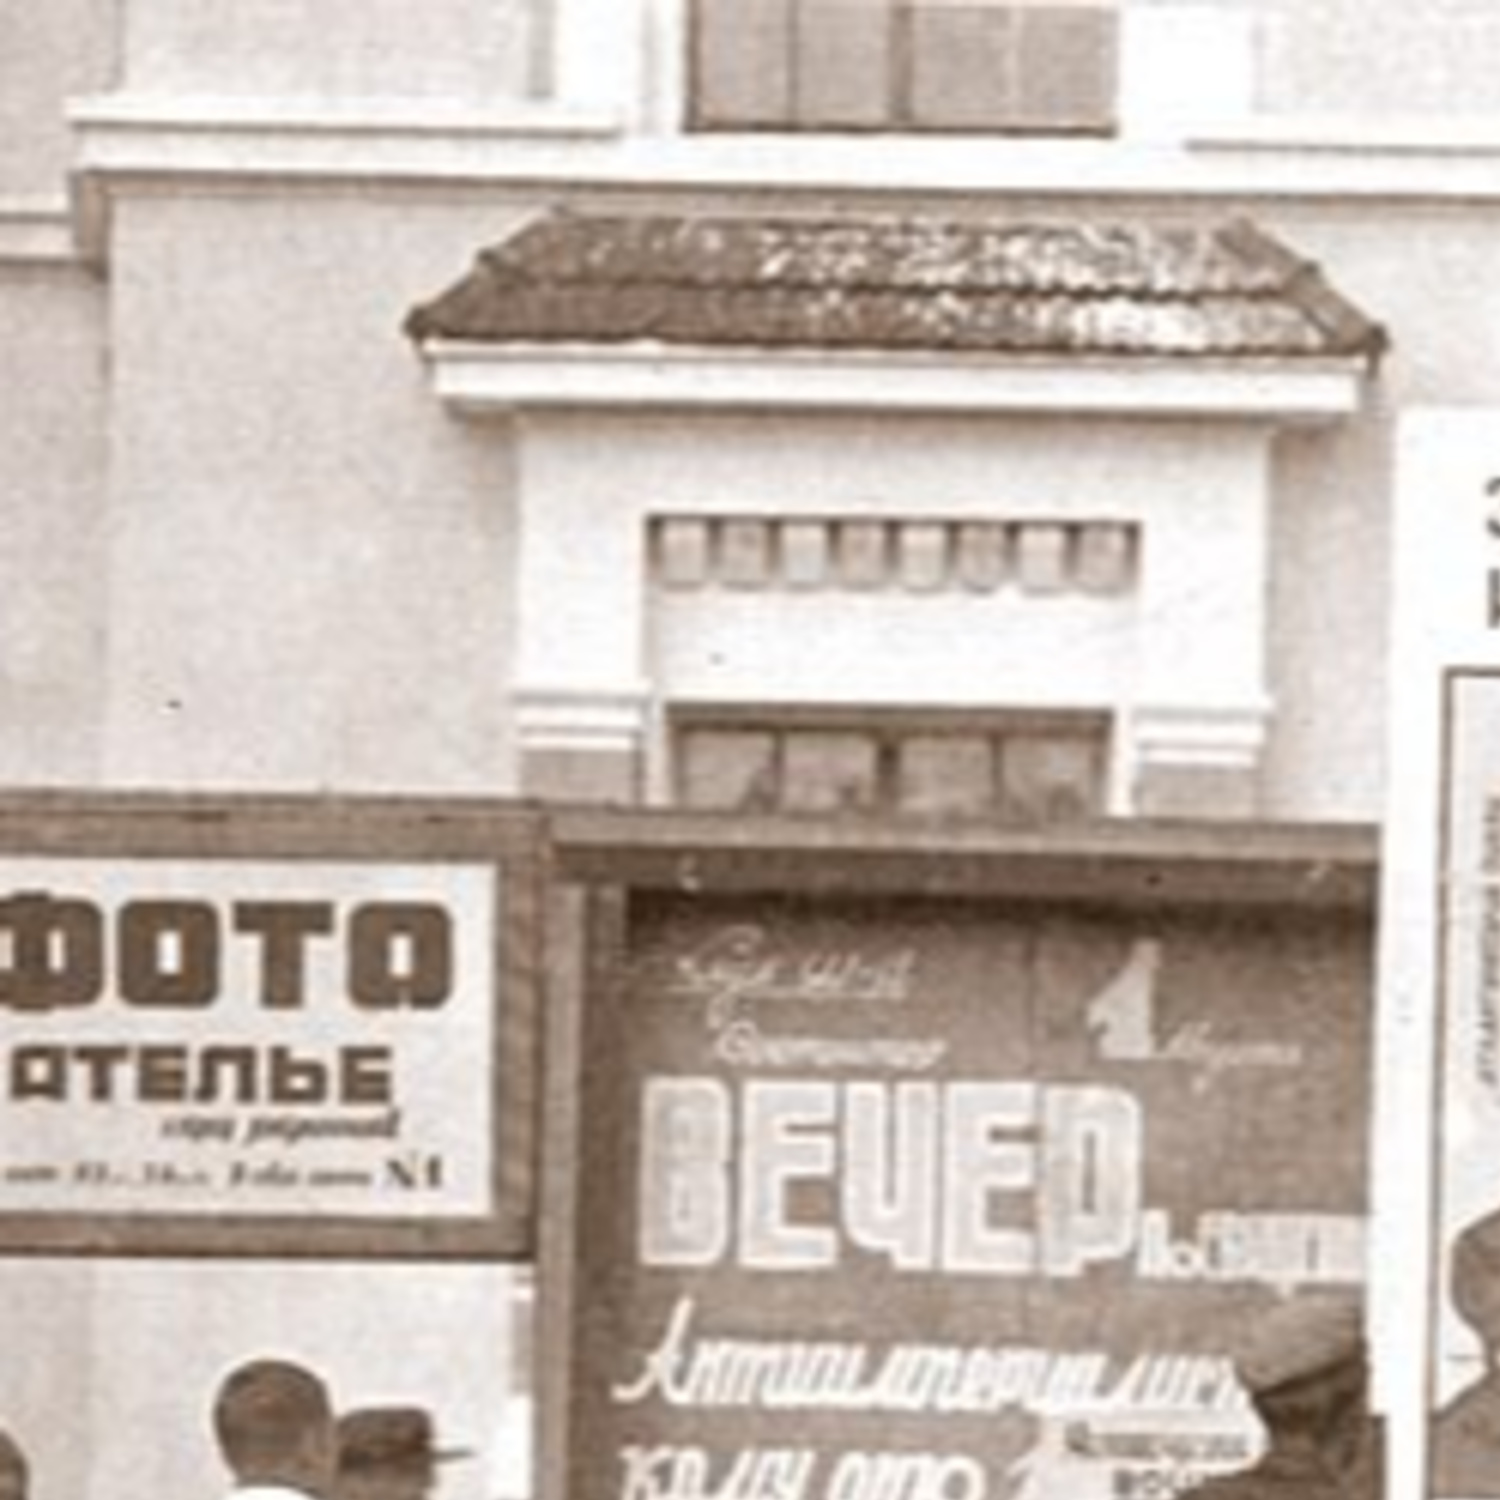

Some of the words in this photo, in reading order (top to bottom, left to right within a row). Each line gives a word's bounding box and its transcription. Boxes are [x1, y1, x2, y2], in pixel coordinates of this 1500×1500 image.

[0, 890, 454, 1012] ФОТО
[10, 1046, 392, 1104] АТЕЛЬЕ
[640, 1076, 1142, 1276] ВЕЧЕР
